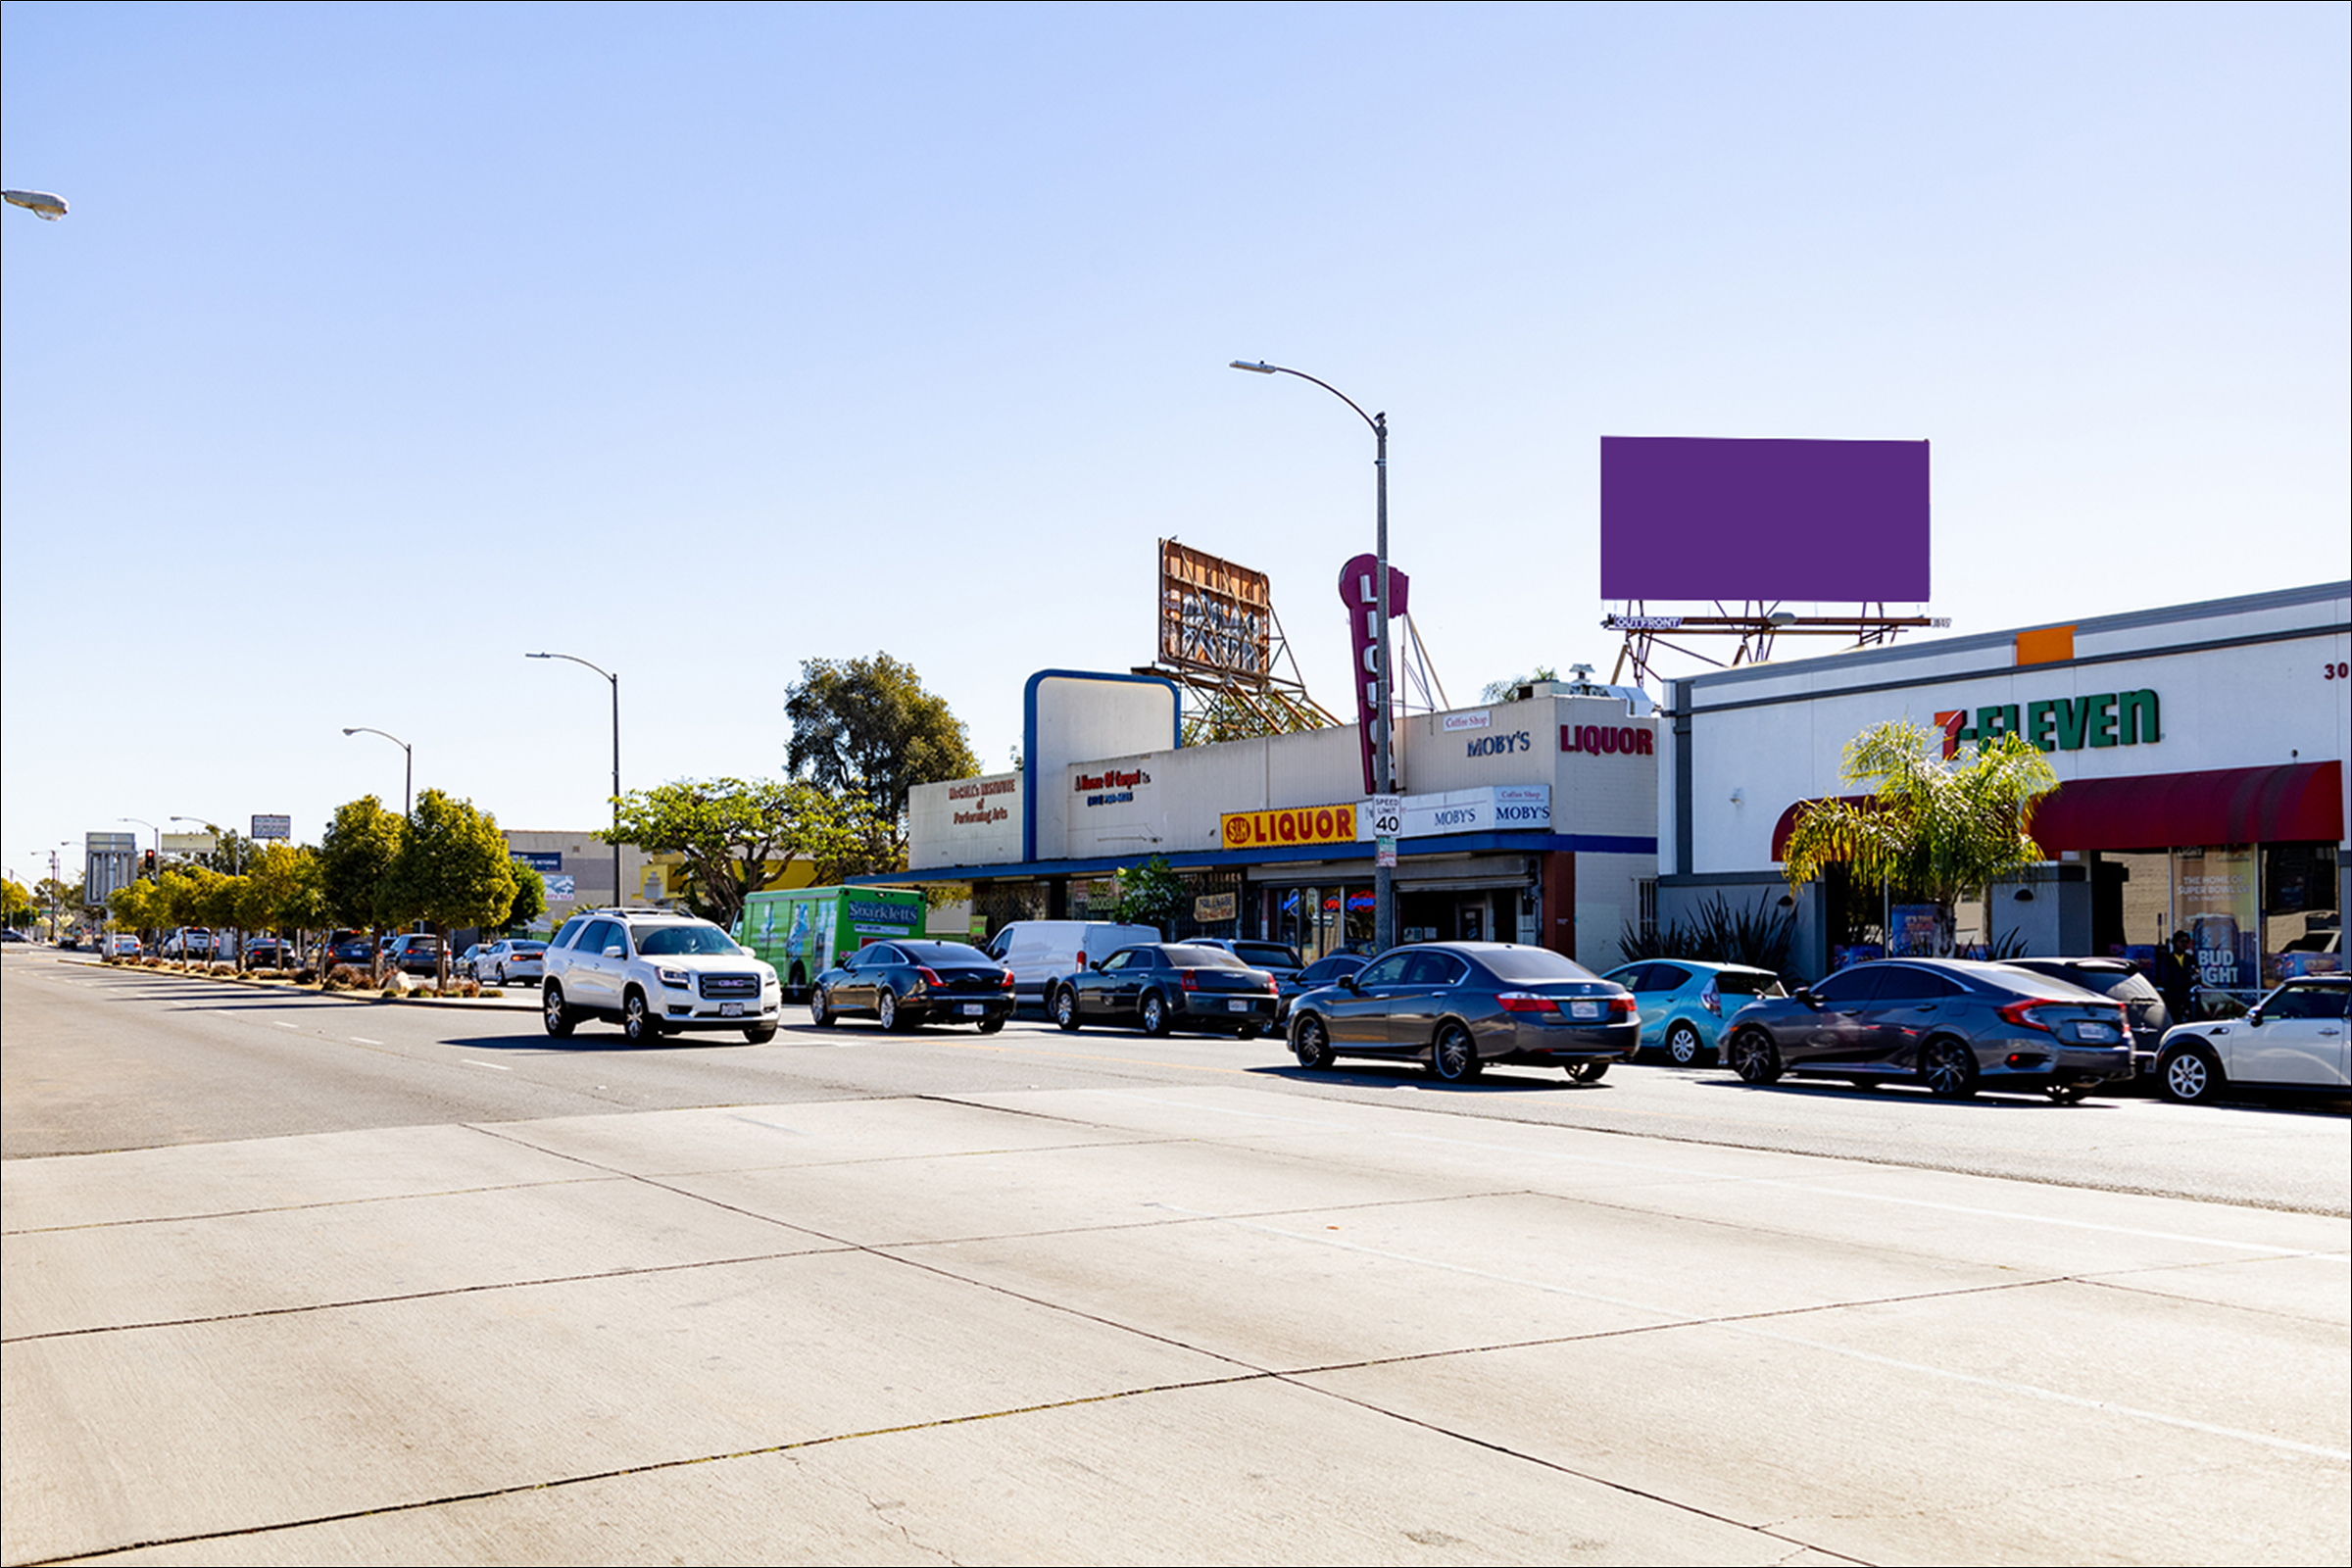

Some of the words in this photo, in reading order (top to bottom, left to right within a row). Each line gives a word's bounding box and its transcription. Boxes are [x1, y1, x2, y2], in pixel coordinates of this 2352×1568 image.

[1616, 616, 1678, 628] OUTFRONT
[1446, 716, 1468, 728] Coffee
[1469, 715, 1488, 727] Shop
[1467, 730, 1531, 758] MOBY'S
[1560, 724, 1653, 757] LIQUOR
[976, 798, 985, 810] of
[992, 807, 1008, 820] Arts
[1435, 808, 1476, 826] MOBY'S
[1495, 806, 1550, 820] MOBY'S
[1254, 808, 1352, 842] LIQUOR
[1376, 815, 1399, 832] 40
[2183, 875, 2200, 885] THE
[2202, 875, 2230, 884] HOME
[2178, 885, 2206, 895] SUPER
[2208, 885, 2235, 894] BOWL
[2198, 950, 2234, 966] BUD
[2200, 967, 2238, 983] IGHT
